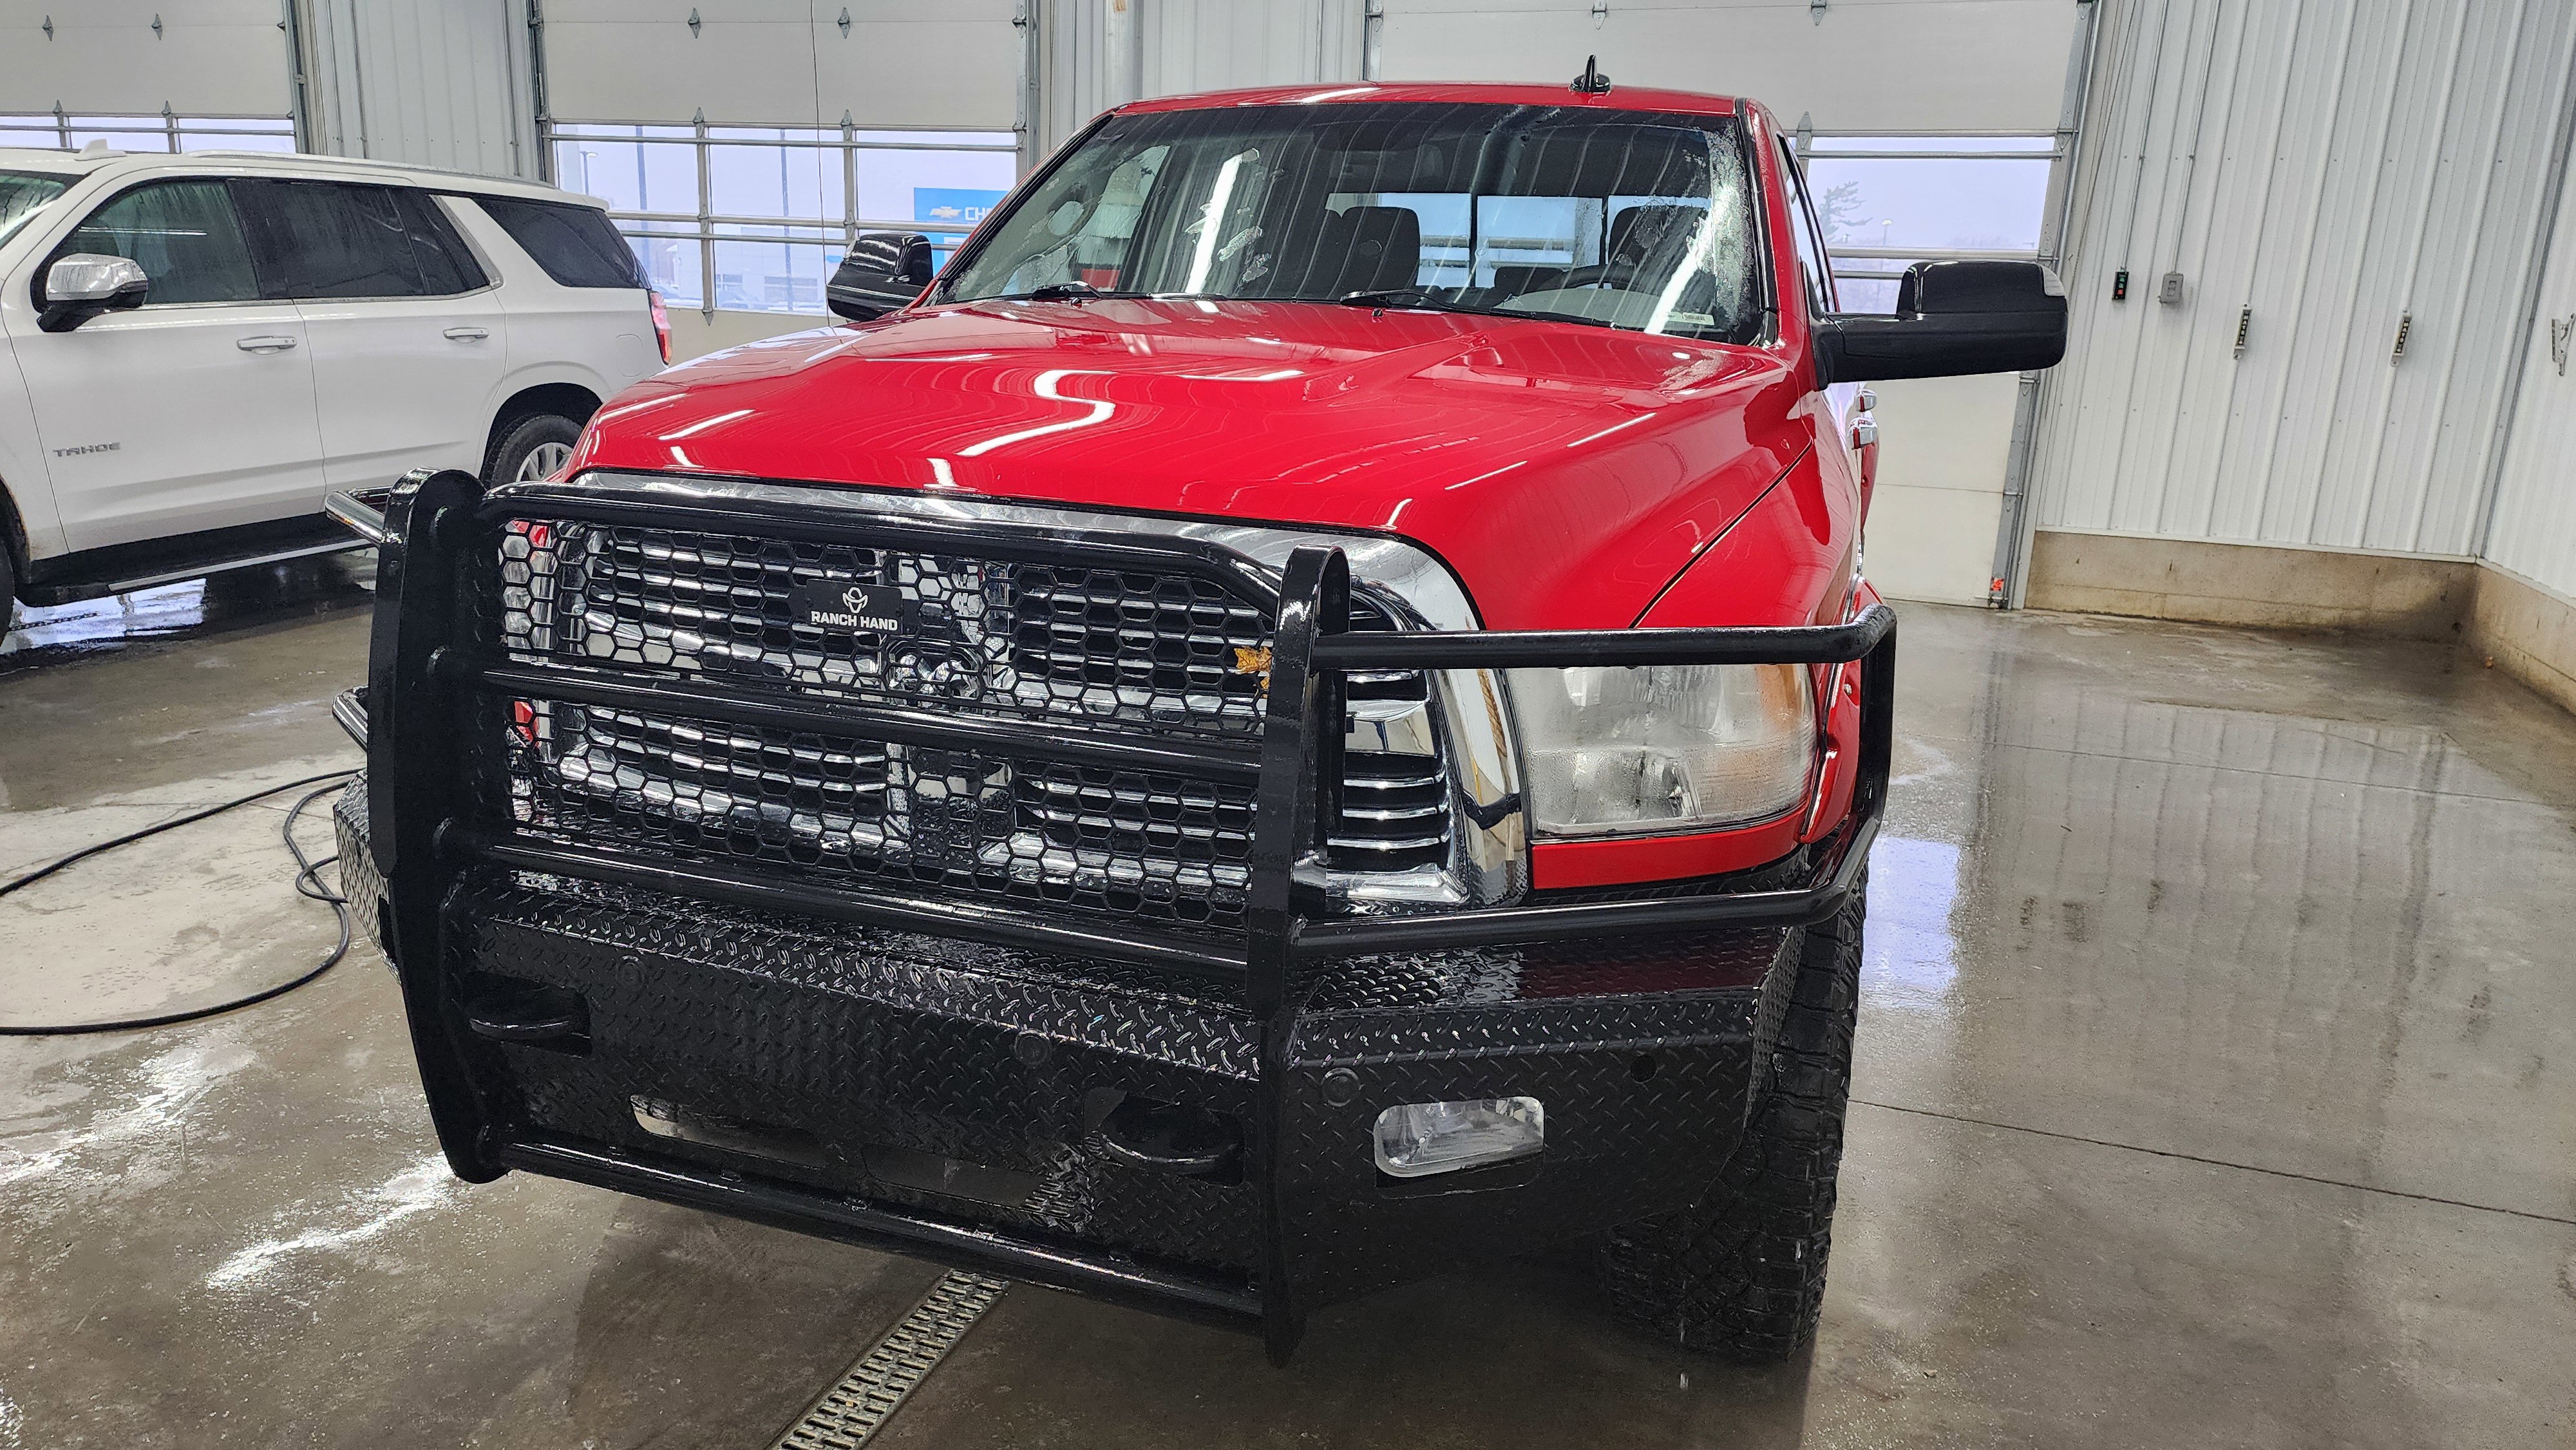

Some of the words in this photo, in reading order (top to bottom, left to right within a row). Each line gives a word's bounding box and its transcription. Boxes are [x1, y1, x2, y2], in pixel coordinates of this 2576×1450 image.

[52, 442, 120, 457] TAHOE
[811, 611, 857, 626] RANCH
[860, 616, 898, 631] HAND
